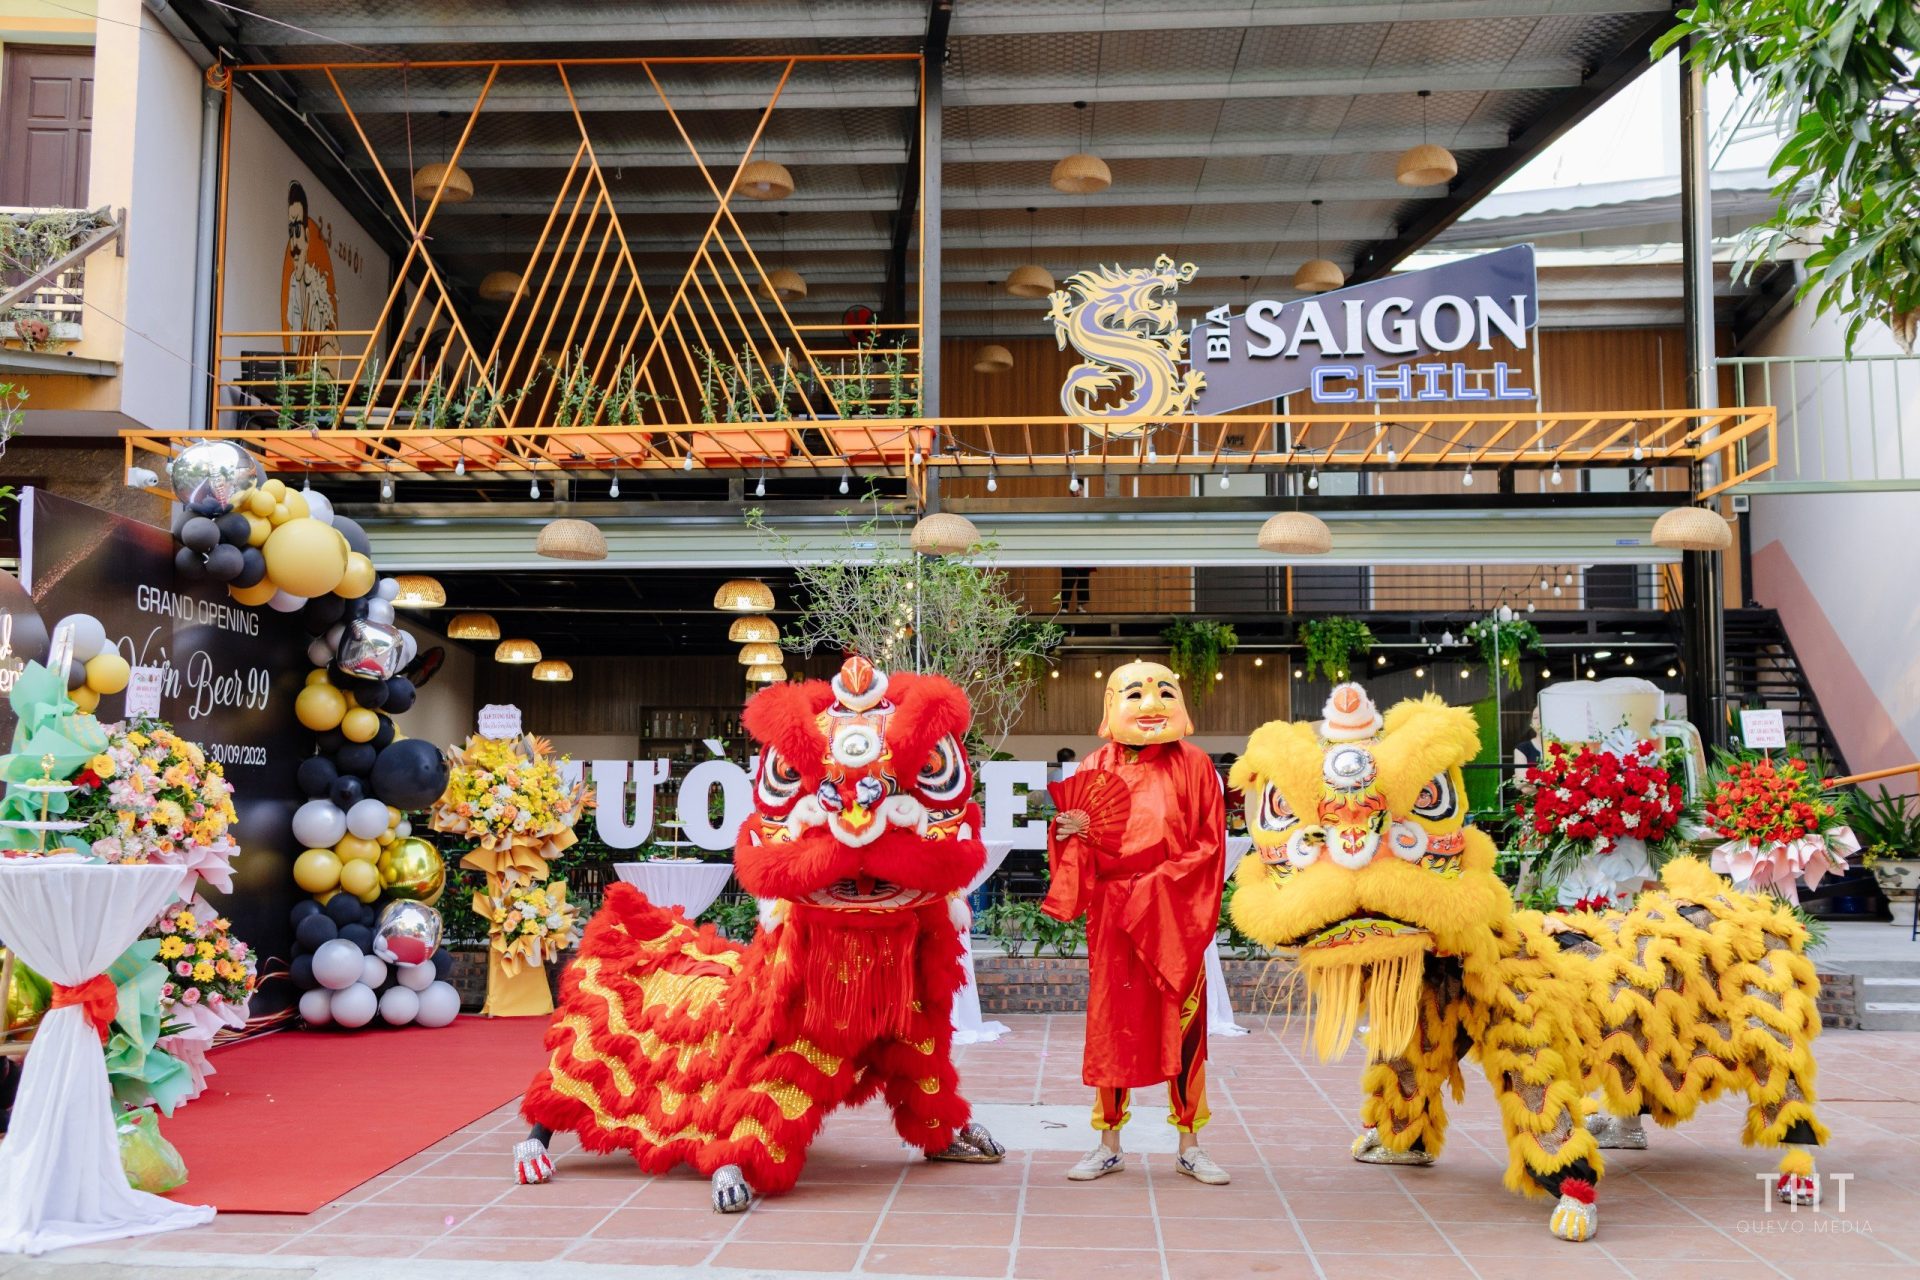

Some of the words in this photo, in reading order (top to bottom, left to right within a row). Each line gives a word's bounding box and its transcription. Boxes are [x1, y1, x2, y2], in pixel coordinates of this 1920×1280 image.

[1206, 303, 1231, 361] BIA
[1245, 294, 1528, 359] SAIGON
[1311, 361, 1533, 404] CHILL
[137, 584, 193, 621] GRAND
[198, 600, 259, 636] OPENING
[187, 650, 244, 720] Beer
[246, 667, 270, 711] 99
[211, 743, 267, 766] 30/09/2023
